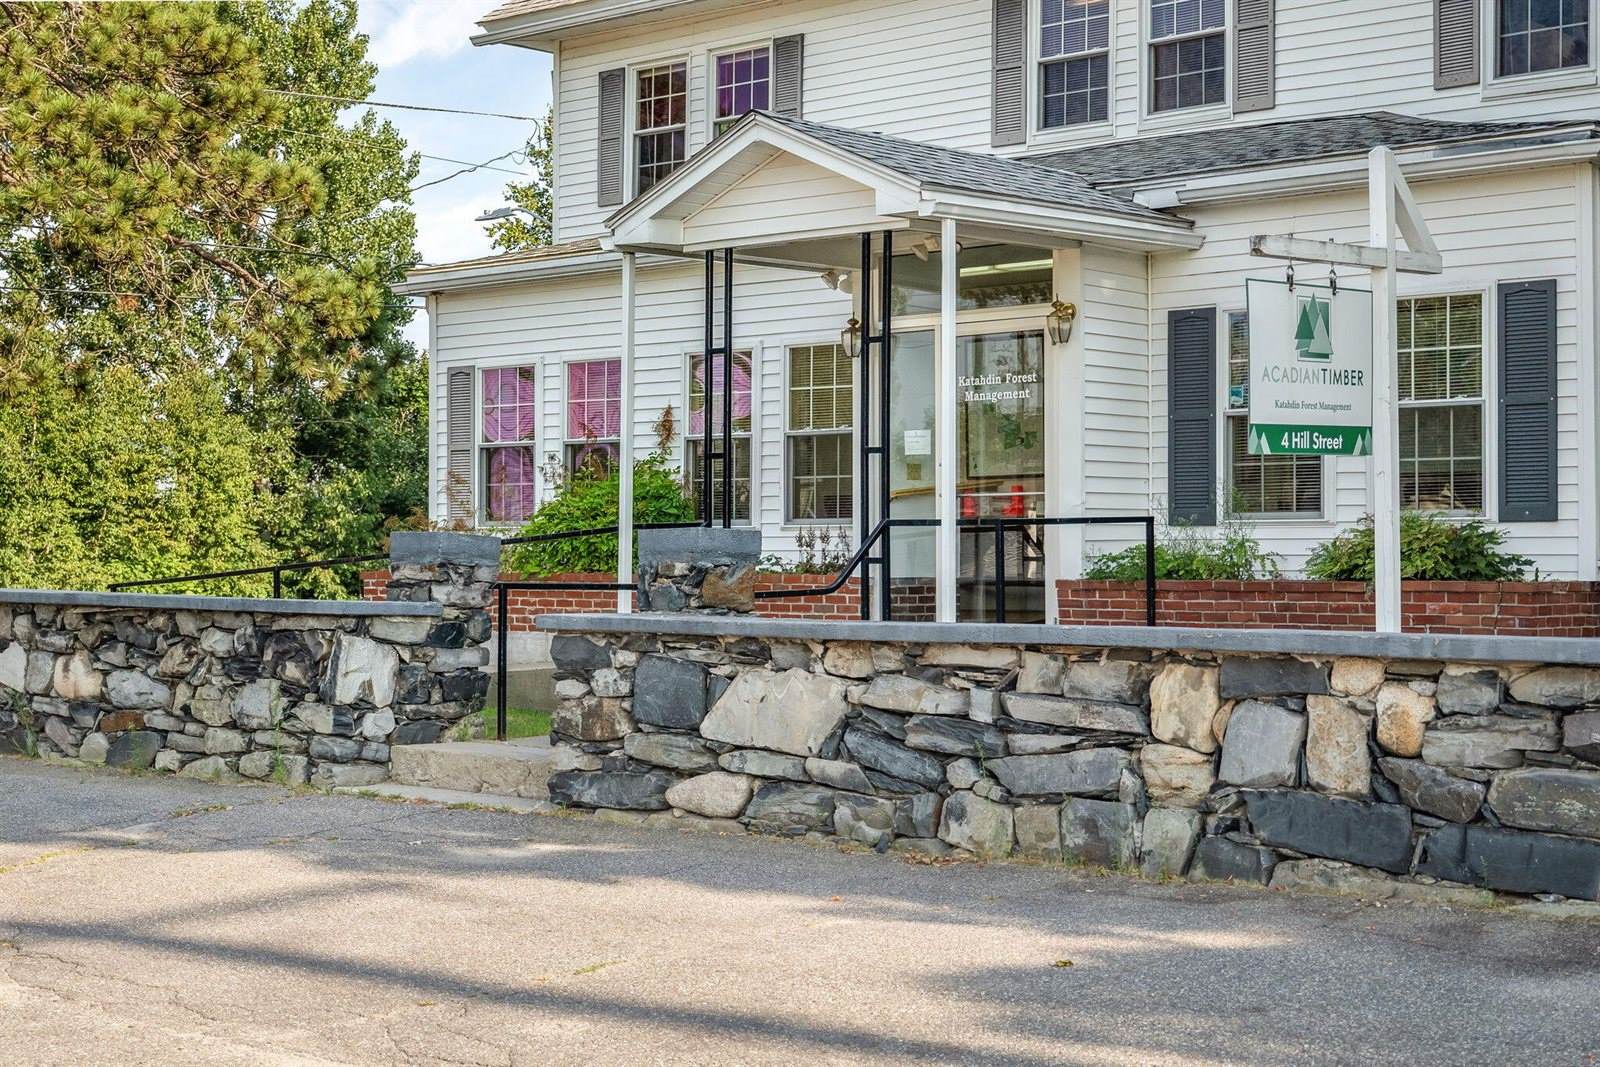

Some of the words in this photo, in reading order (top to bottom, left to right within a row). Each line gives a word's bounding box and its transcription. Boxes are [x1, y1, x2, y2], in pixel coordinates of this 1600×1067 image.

[958, 374, 1002, 387] Katahdin
[1006, 372, 1037, 384] Forest
[964, 388, 1031, 403] Management
[1274, 399, 1300, 409] Katahdin
[1301, 400, 1318, 410] Forest
[1319, 401, 1352, 412] Management
[1280, 432, 1289, 449] 4
[1292, 431, 1310, 449] Hill
[1313, 431, 1343, 450] Street
